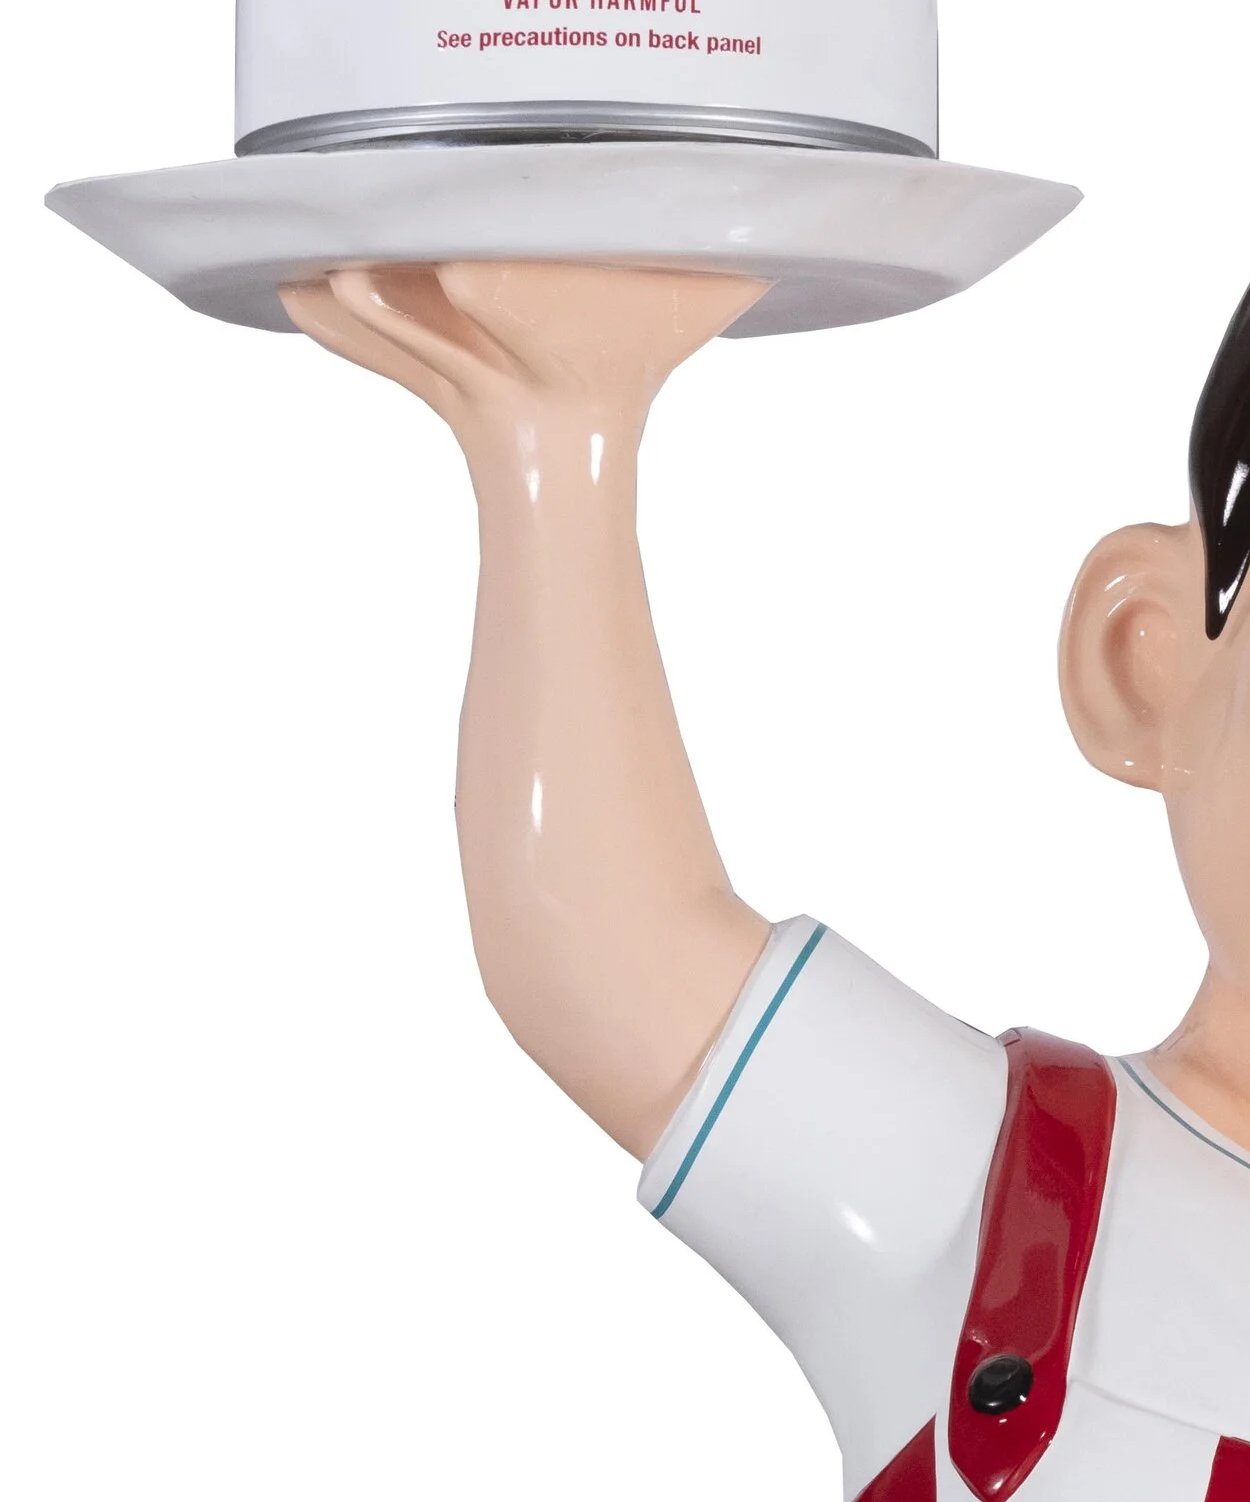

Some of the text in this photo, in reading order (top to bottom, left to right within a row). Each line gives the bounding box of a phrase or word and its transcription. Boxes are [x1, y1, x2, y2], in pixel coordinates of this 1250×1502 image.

[437, 26, 761, 55] See precautions on back panel
